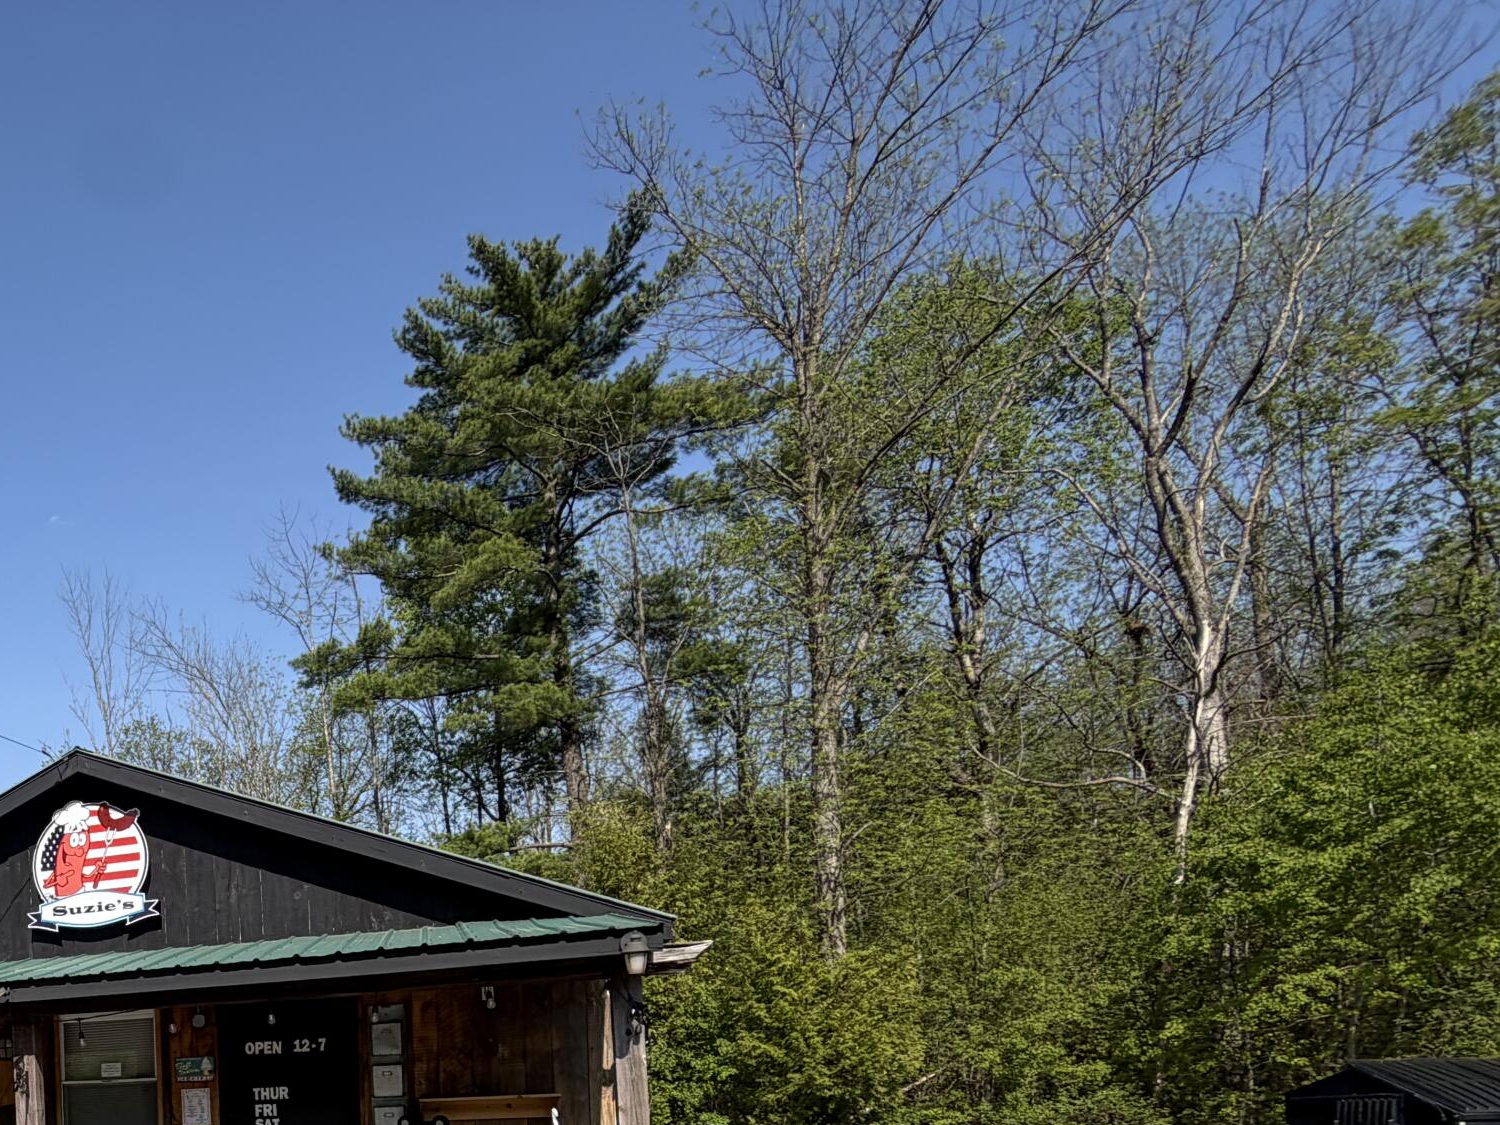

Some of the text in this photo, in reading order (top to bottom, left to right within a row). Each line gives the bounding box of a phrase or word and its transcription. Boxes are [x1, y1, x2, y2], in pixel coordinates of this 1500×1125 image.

[52, 899, 135, 916] Suzie's
[245, 1041, 282, 1055] OPEN
[252, 1086, 289, 1100] THUR
[255, 1104, 277, 1117] FRI
